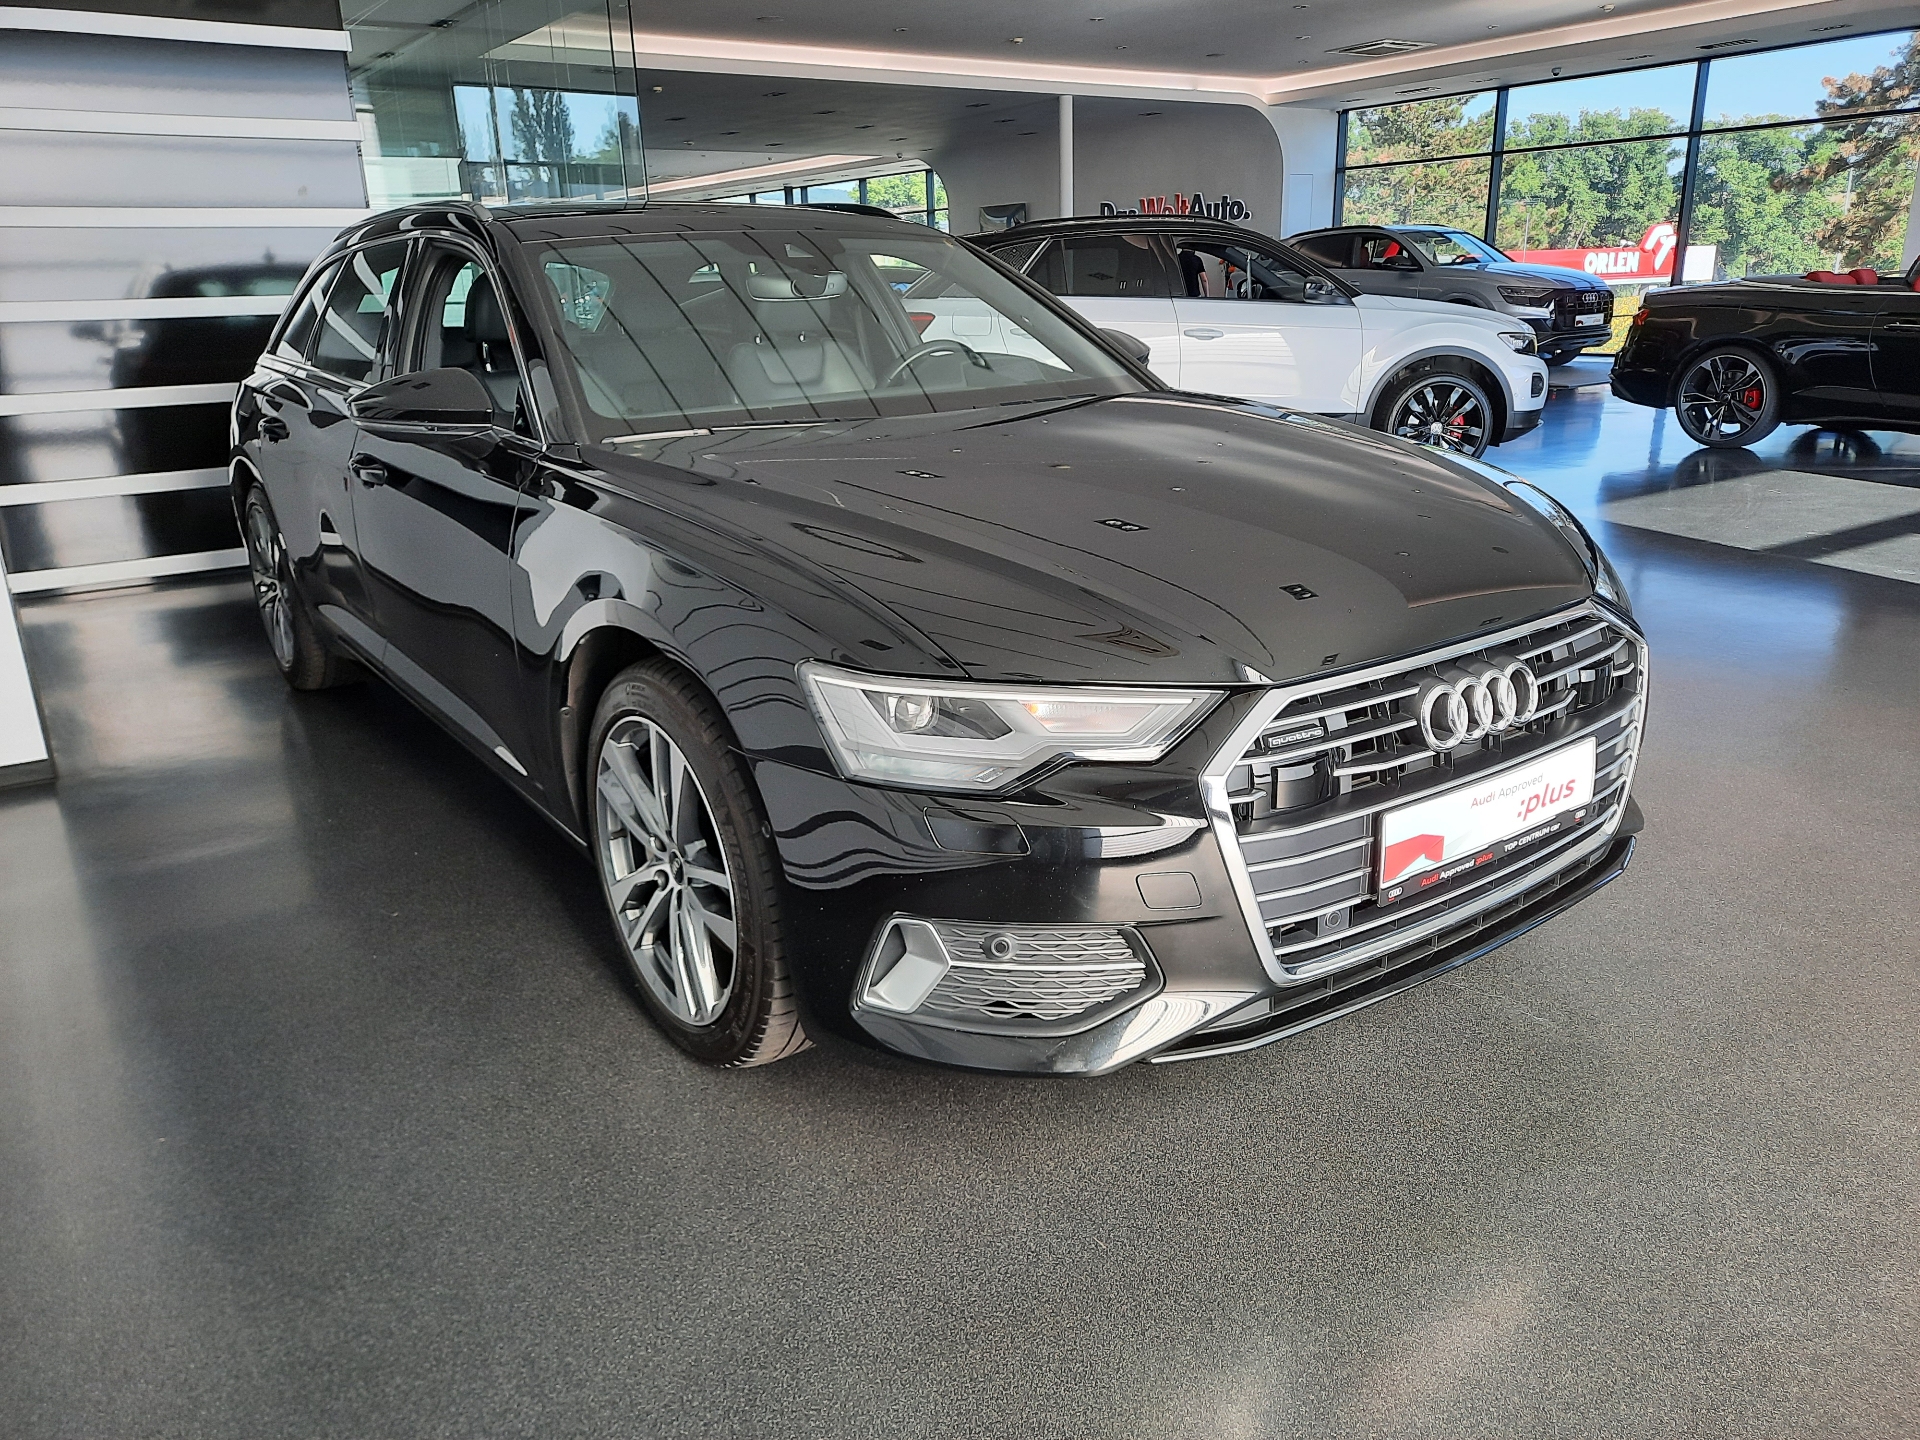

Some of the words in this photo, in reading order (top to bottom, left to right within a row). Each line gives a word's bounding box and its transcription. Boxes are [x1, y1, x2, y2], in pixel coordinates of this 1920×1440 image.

[1584, 251, 1640, 274] ORLEN
[1272, 729, 1322, 746] quattro
[1470, 791, 1496, 809] Audi
[1498, 773, 1544, 800] Approved
[1504, 841, 1519, 853] TOP
[1518, 828, 1550, 847] CENTRUM
[1549, 822, 1562, 834] car
[1420, 873, 1439, 887] Audi
[1439, 858, 1475, 880] Approved
